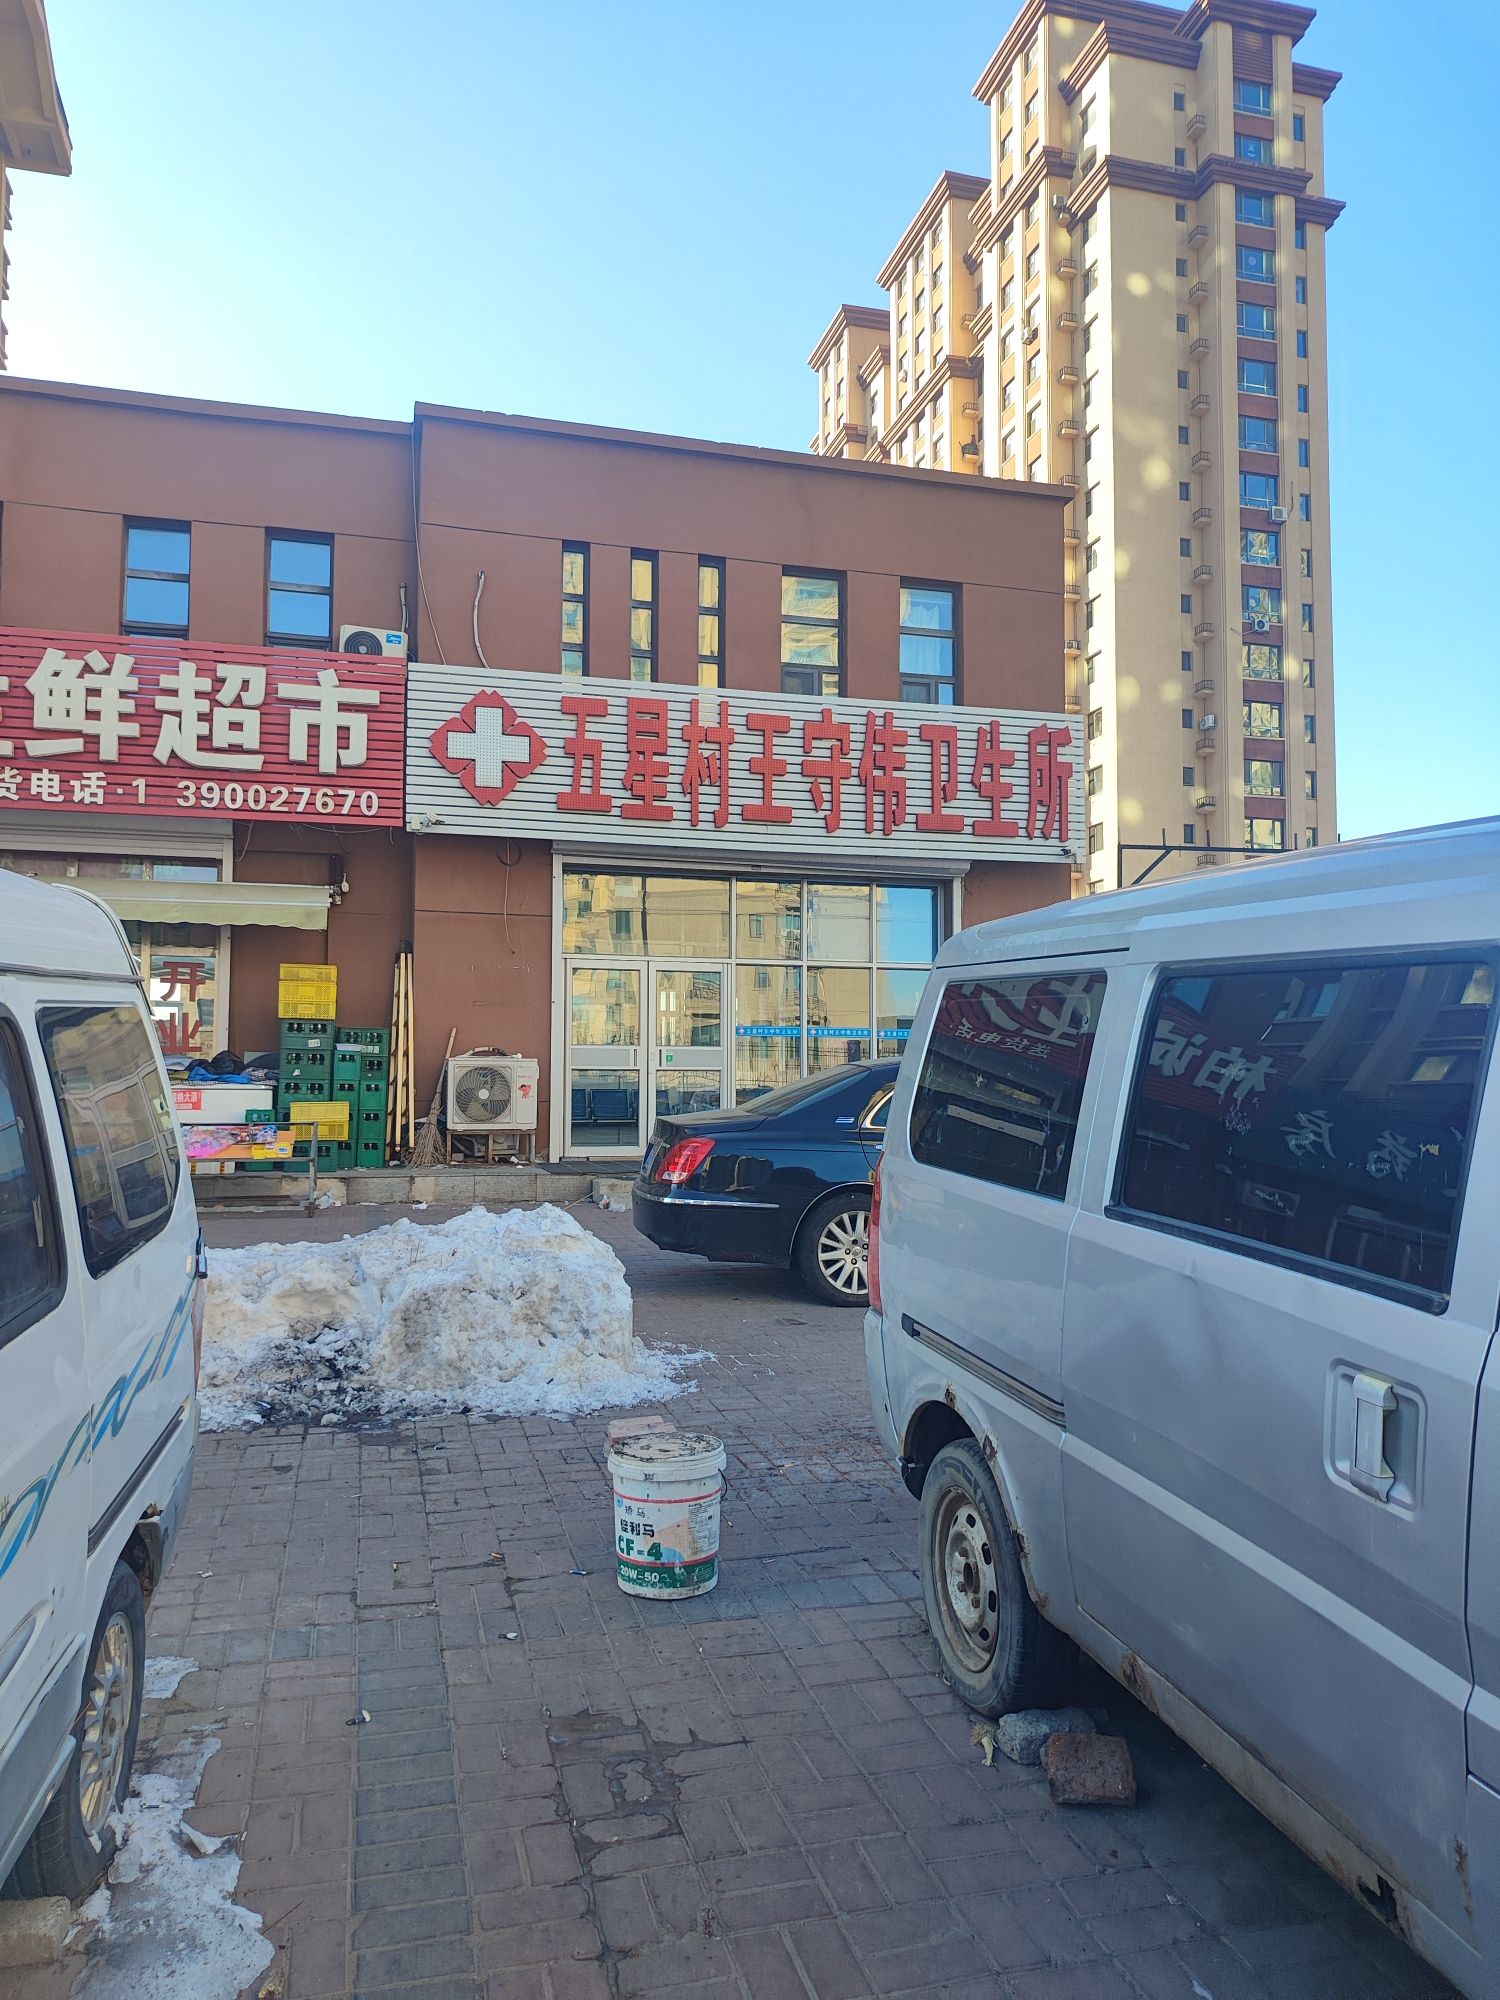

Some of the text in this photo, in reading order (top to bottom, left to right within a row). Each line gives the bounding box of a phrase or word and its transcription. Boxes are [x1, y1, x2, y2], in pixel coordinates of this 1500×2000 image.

[0, 648, 380, 775] 鲜超市
[176, 781, 379, 816] 390027670
[556, 695, 1073, 842] 五星村王守伟卫生所
[158, 961, 206, 1052] 开业
[618, 1535, 663, 1561] CF-4
